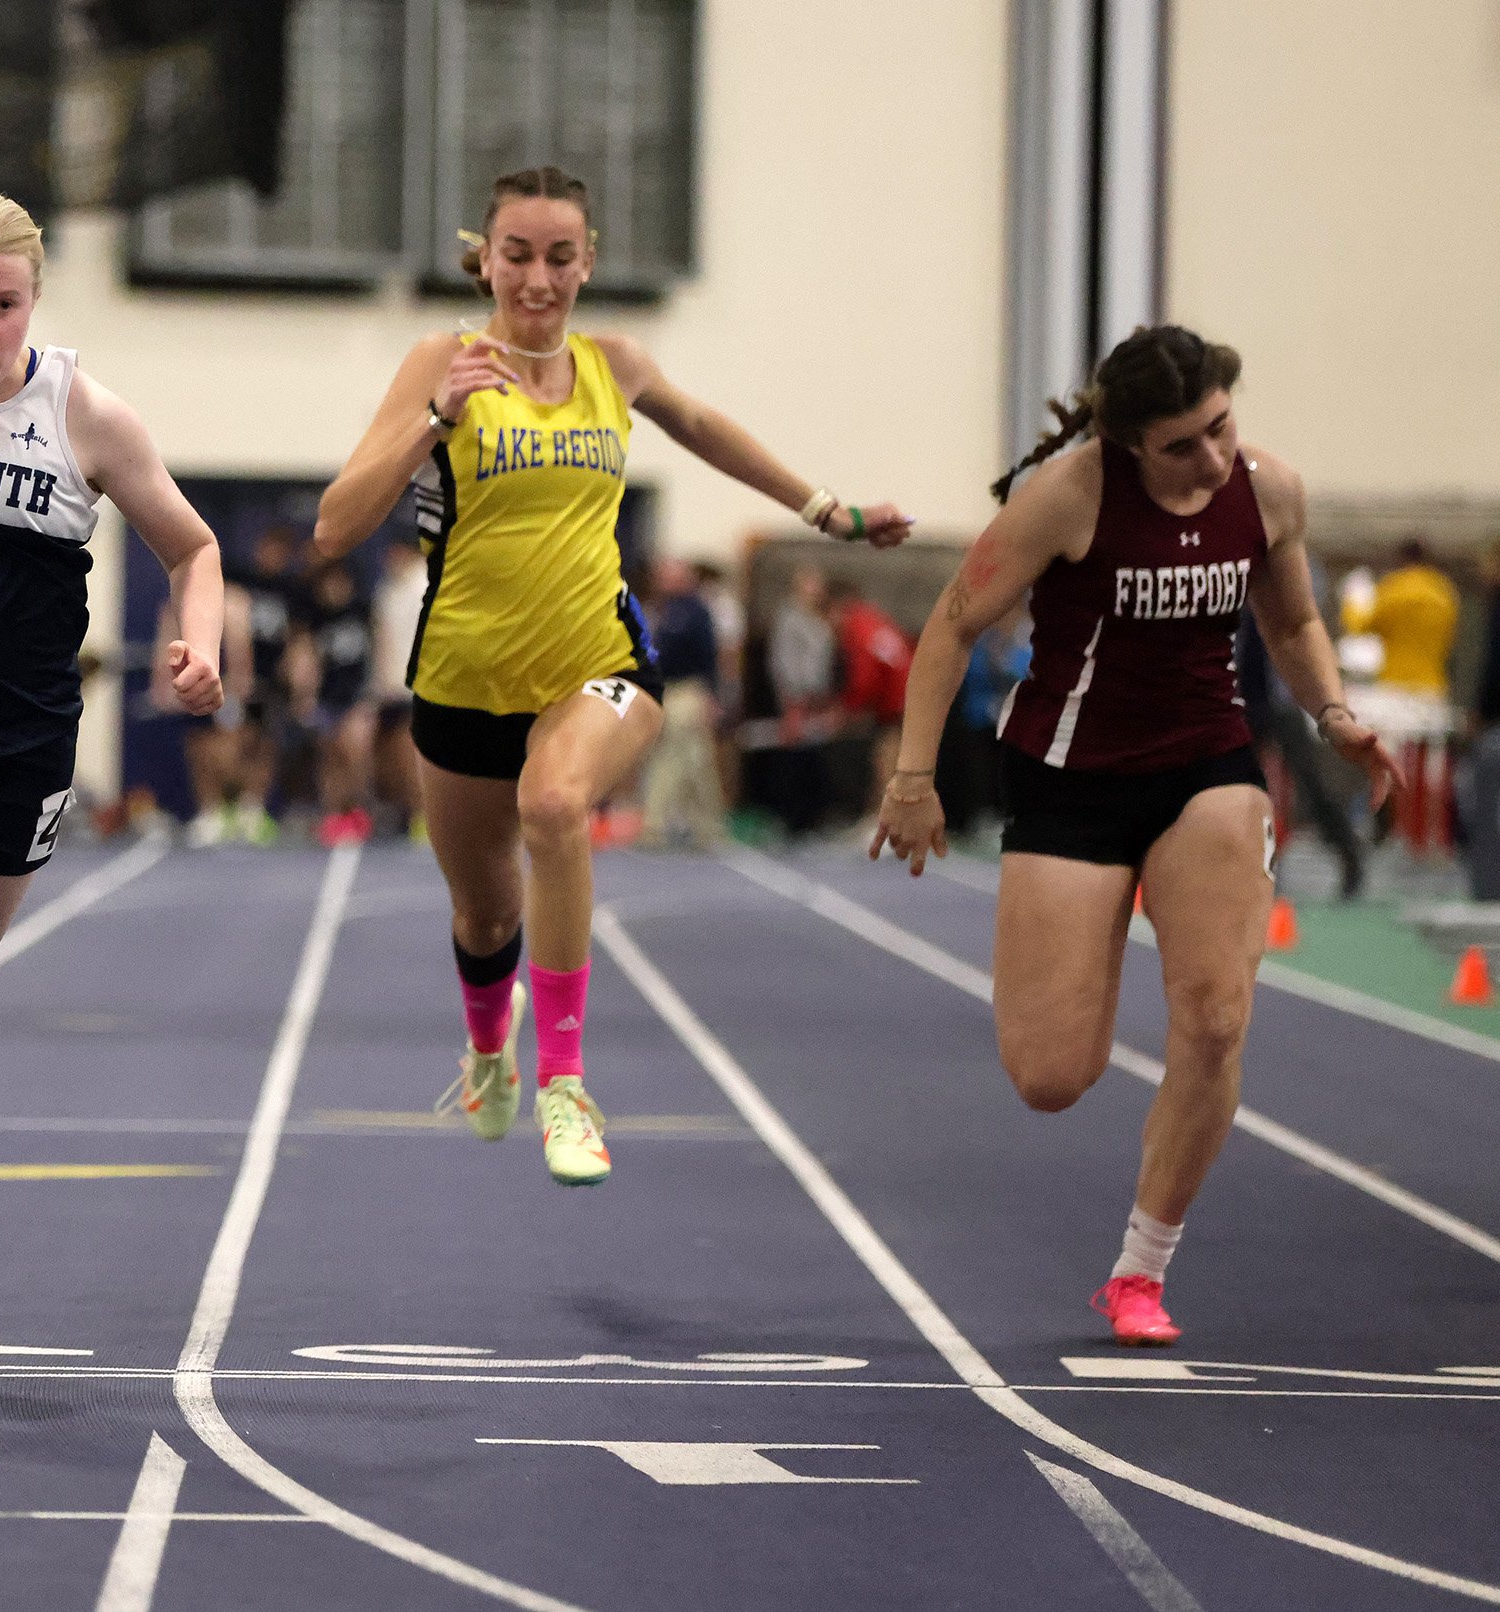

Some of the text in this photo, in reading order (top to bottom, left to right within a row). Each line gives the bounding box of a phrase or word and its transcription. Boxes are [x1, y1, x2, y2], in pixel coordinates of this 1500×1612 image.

[476, 427, 544, 481] LAKE
[1114, 558, 1250, 620] FREEPORT
[36, 793, 68, 853] 4
